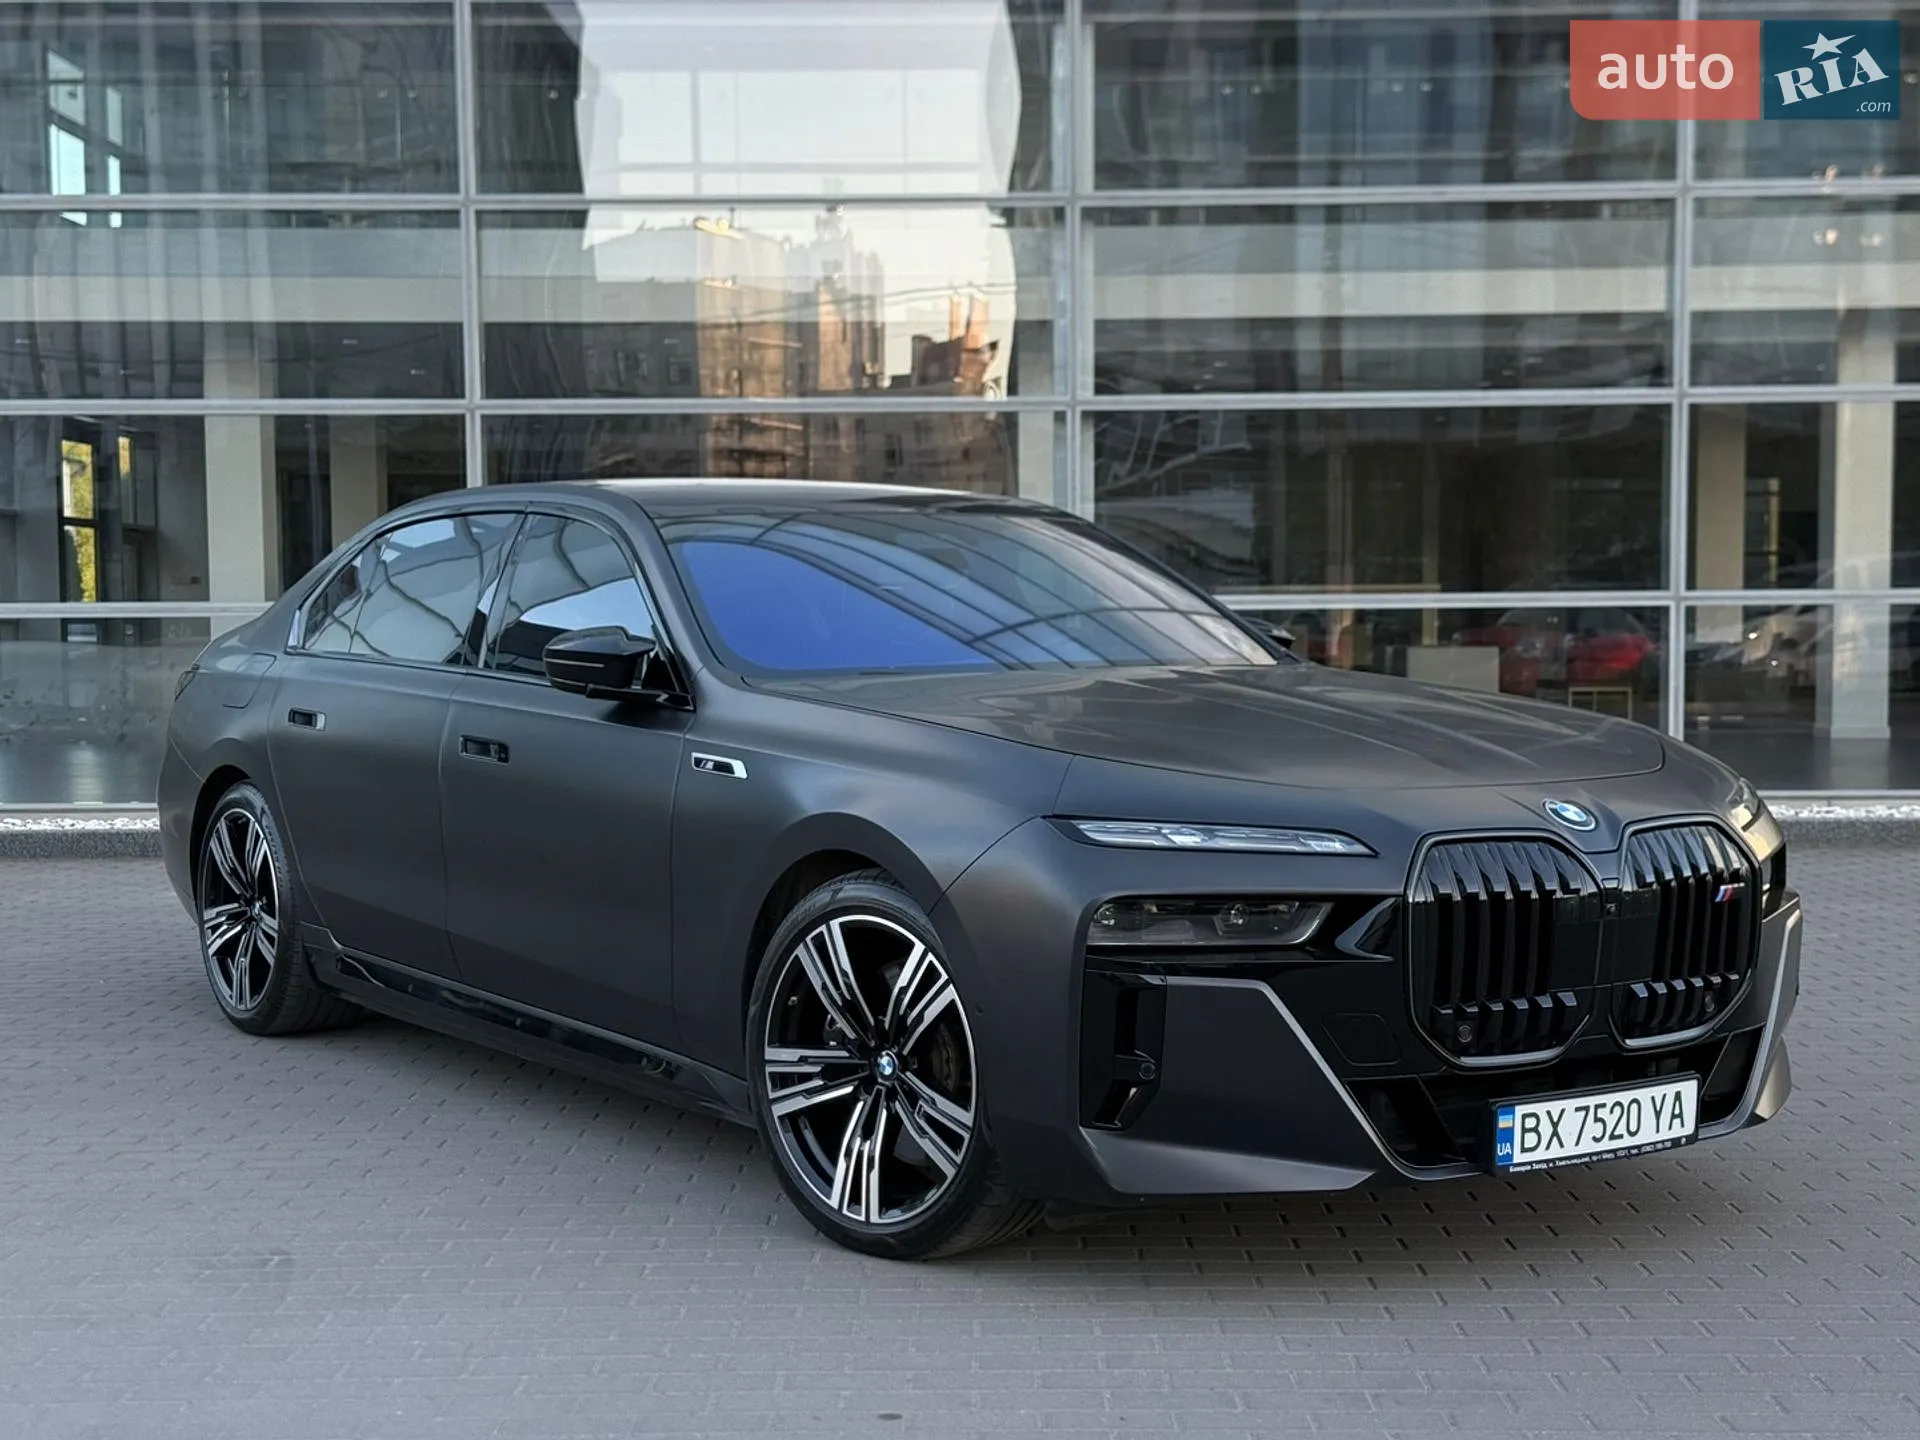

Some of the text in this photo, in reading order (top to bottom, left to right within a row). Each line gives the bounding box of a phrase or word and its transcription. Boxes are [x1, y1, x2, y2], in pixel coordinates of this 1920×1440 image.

[1520, 1090, 1685, 1154] BX 7520 YA
[1497, 1142, 1512, 1156] UA
